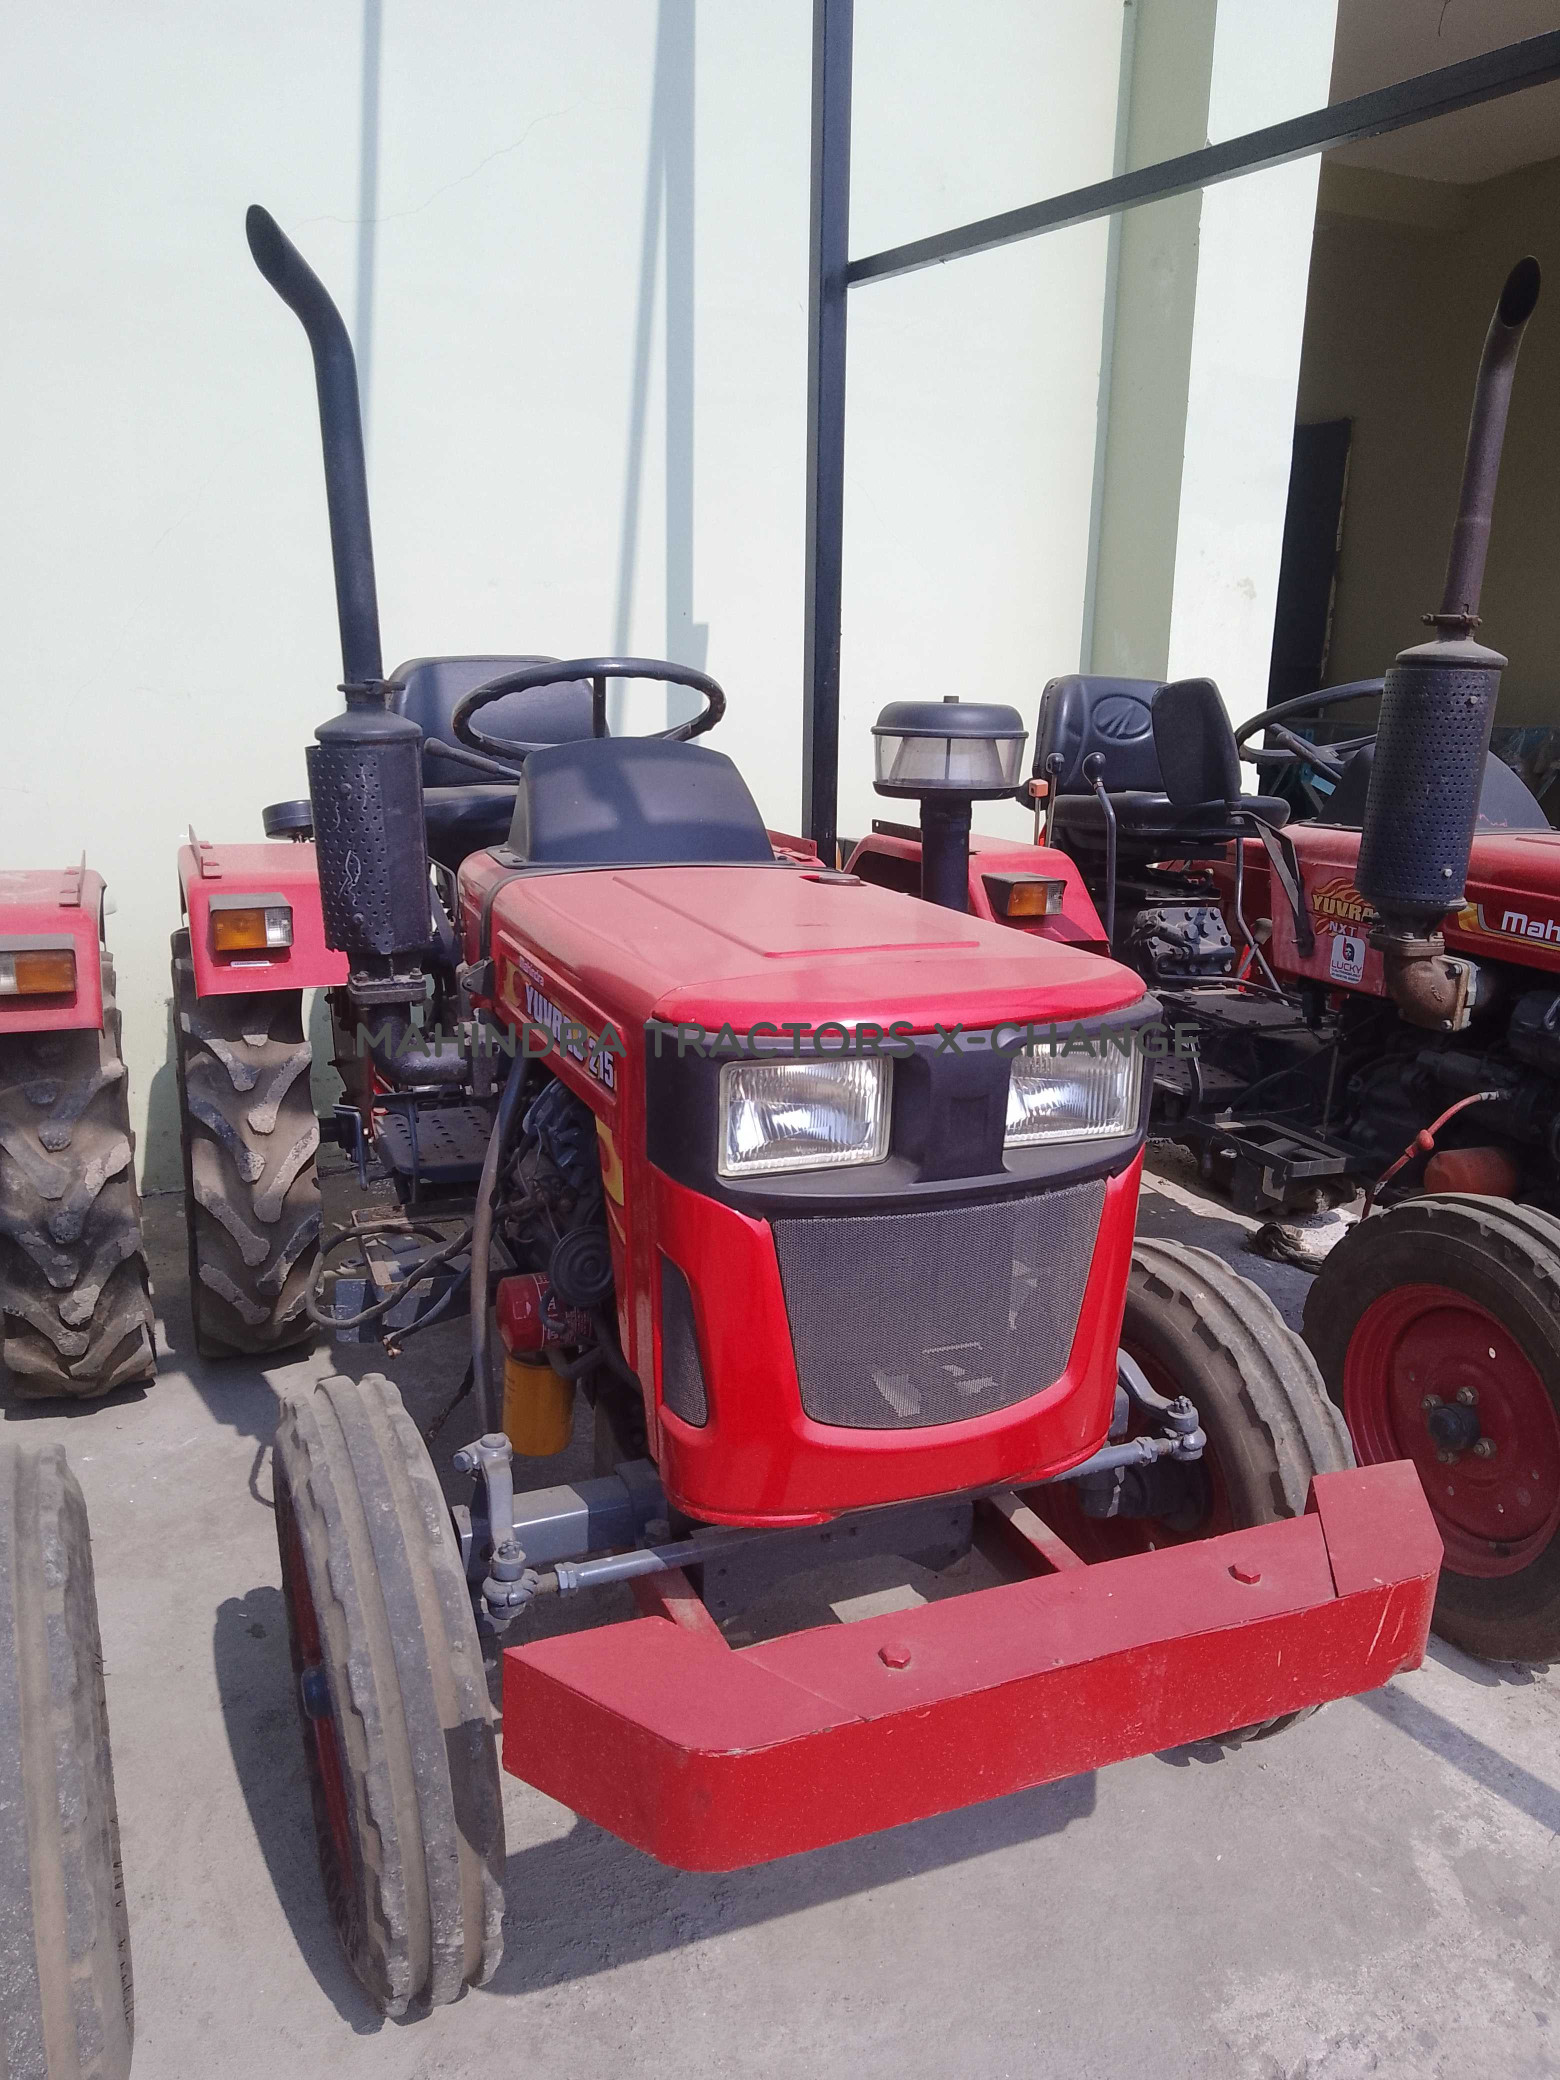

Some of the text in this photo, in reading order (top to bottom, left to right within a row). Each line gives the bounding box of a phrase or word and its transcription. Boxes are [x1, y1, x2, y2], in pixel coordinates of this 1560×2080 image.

[1312, 894, 1375, 922] YUVRA
[1329, 920, 1358, 937] NXT
[1331, 960, 1362, 974] LUCKY
[588, 1036, 614, 1088] 215
